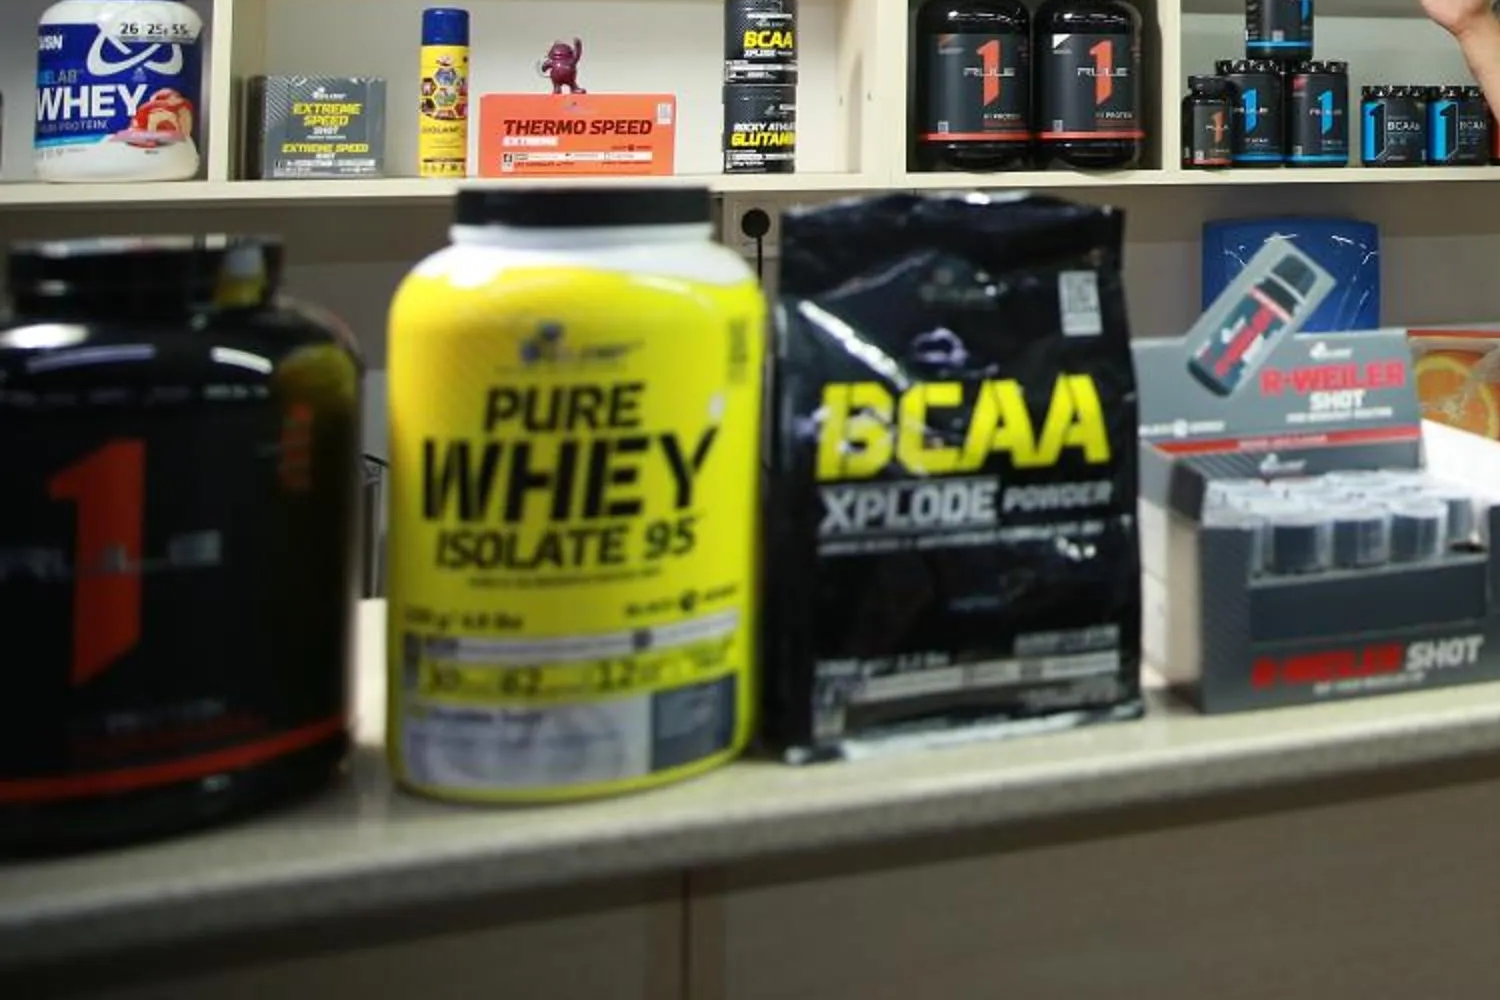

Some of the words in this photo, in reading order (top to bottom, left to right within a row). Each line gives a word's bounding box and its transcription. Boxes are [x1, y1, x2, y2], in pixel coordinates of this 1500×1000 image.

[120, 22, 139, 35] 26
[743, 31, 793, 48] BCAA
[963, 67, 1016, 77] RULE
[977, 39, 1001, 106] 1
[1077, 67, 1128, 77] RULE
[1089, 39, 1114, 105] 1
[37, 84, 148, 122] WHEY
[292, 103, 362, 116] EXTREME
[303, 115, 349, 128] SPEED
[503, 119, 586, 136] THERMO
[589, 119, 653, 136] SPEED
[281, 143, 333, 153] EXTREME
[335, 143, 369, 153] SPEED
[1259, 361, 1405, 396] R-WEILER
[484, 382, 645, 433] PURE
[1309, 389, 1367, 411] SHOT
[815, 373, 1112, 480] BCAA
[422, 426, 720, 522] WHEY
[820, 480, 996, 534] XPLODE
[1003, 481, 1112, 513] POWDER
[435, 525, 631, 571] ISOLATE
[644, 517, 700, 560] 95
[47, 437, 147, 688] 1
[1406, 634, 1484, 672] SHOT
